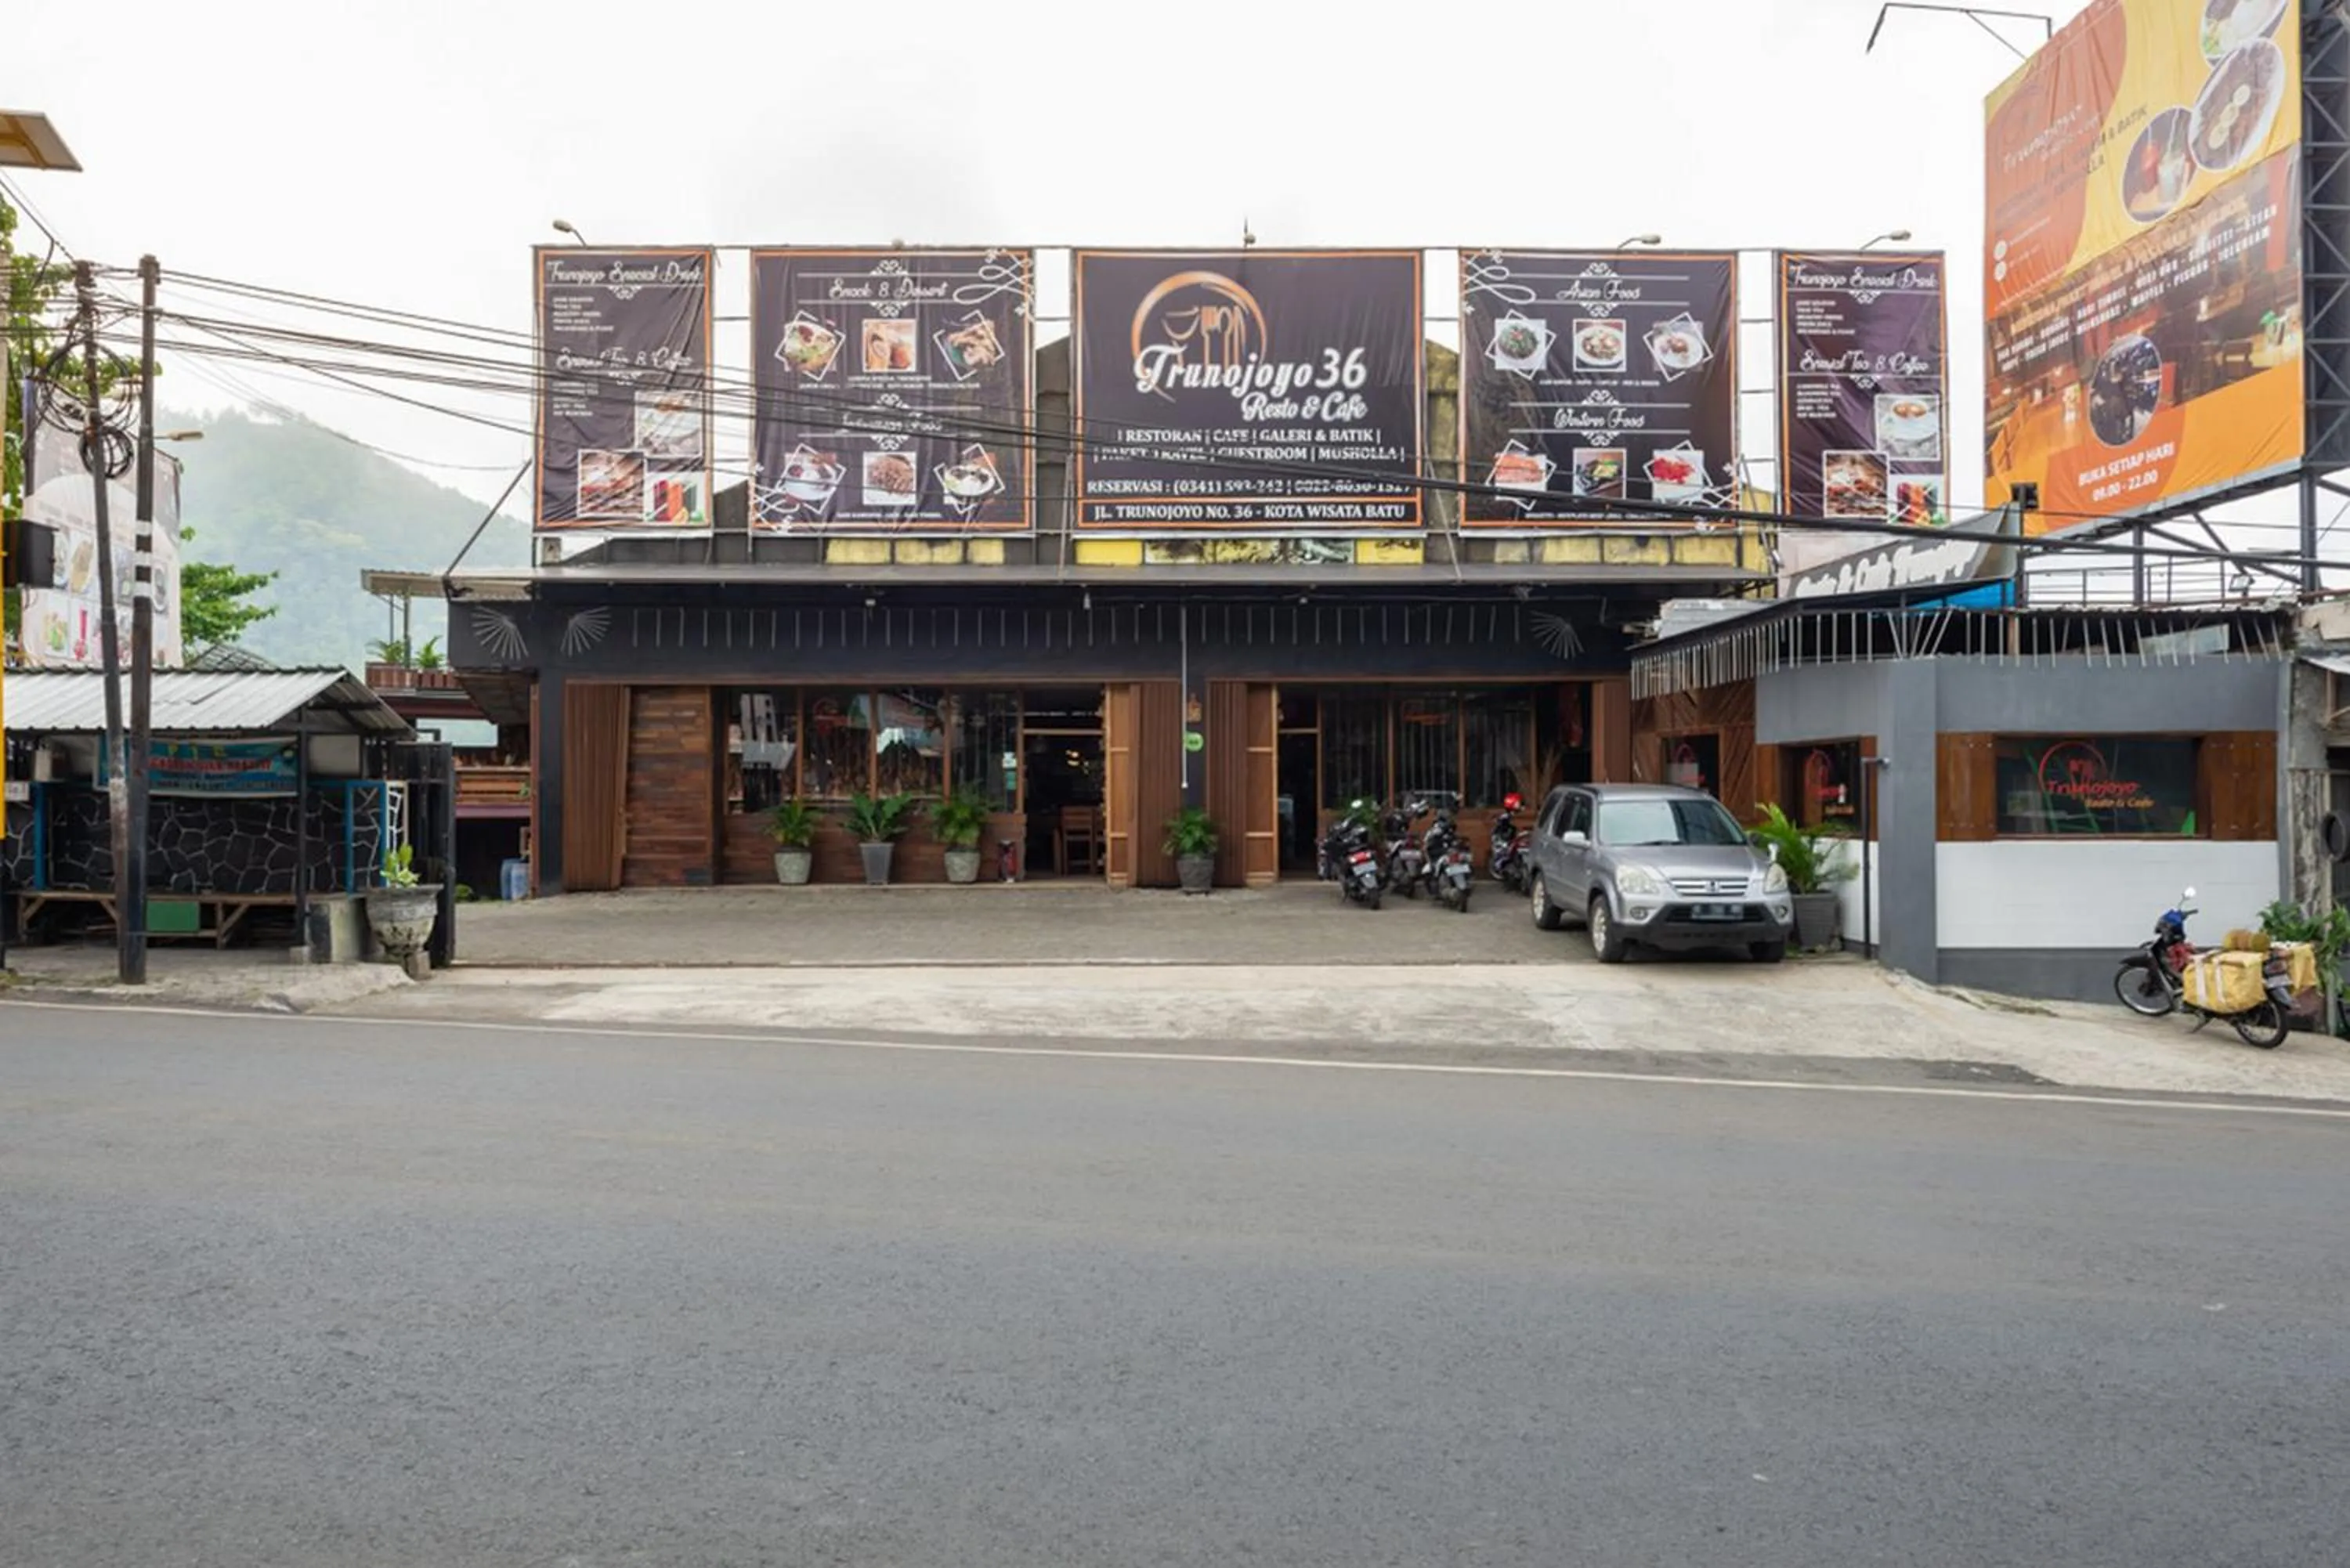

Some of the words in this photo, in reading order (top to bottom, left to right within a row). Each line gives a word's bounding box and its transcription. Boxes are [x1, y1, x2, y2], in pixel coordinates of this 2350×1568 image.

[1603, 279, 1642, 301] Food
[1133, 344, 1314, 398] Trunojoyo
[1314, 347, 1368, 389] 36
[1241, 392, 1298, 421] Resto
[1301, 395, 1321, 419] &
[1321, 391, 1368, 421] Cafe
[1607, 407, 1644, 428] Food
[1126, 429, 1202, 442] RESTORAN
[1213, 428, 1249, 443] CAFE
[1259, 428, 1312, 442] GALERI
[1314, 428, 1327, 442] &
[1329, 428, 1374, 442] BATIK
[1318, 446, 1398, 461] MUSHOLLA
[1174, 479, 1222, 495] (0341)
[1094, 505, 1112, 520] JL.
[1115, 505, 1203, 520] TRUNOJOYO
[1206, 505, 1231, 518] NO.
[1235, 505, 1253, 518] 36
[1264, 504, 1305, 518] KOTA
[1306, 504, 1363, 518] WISATA
[1365, 504, 1406, 518] BATU
